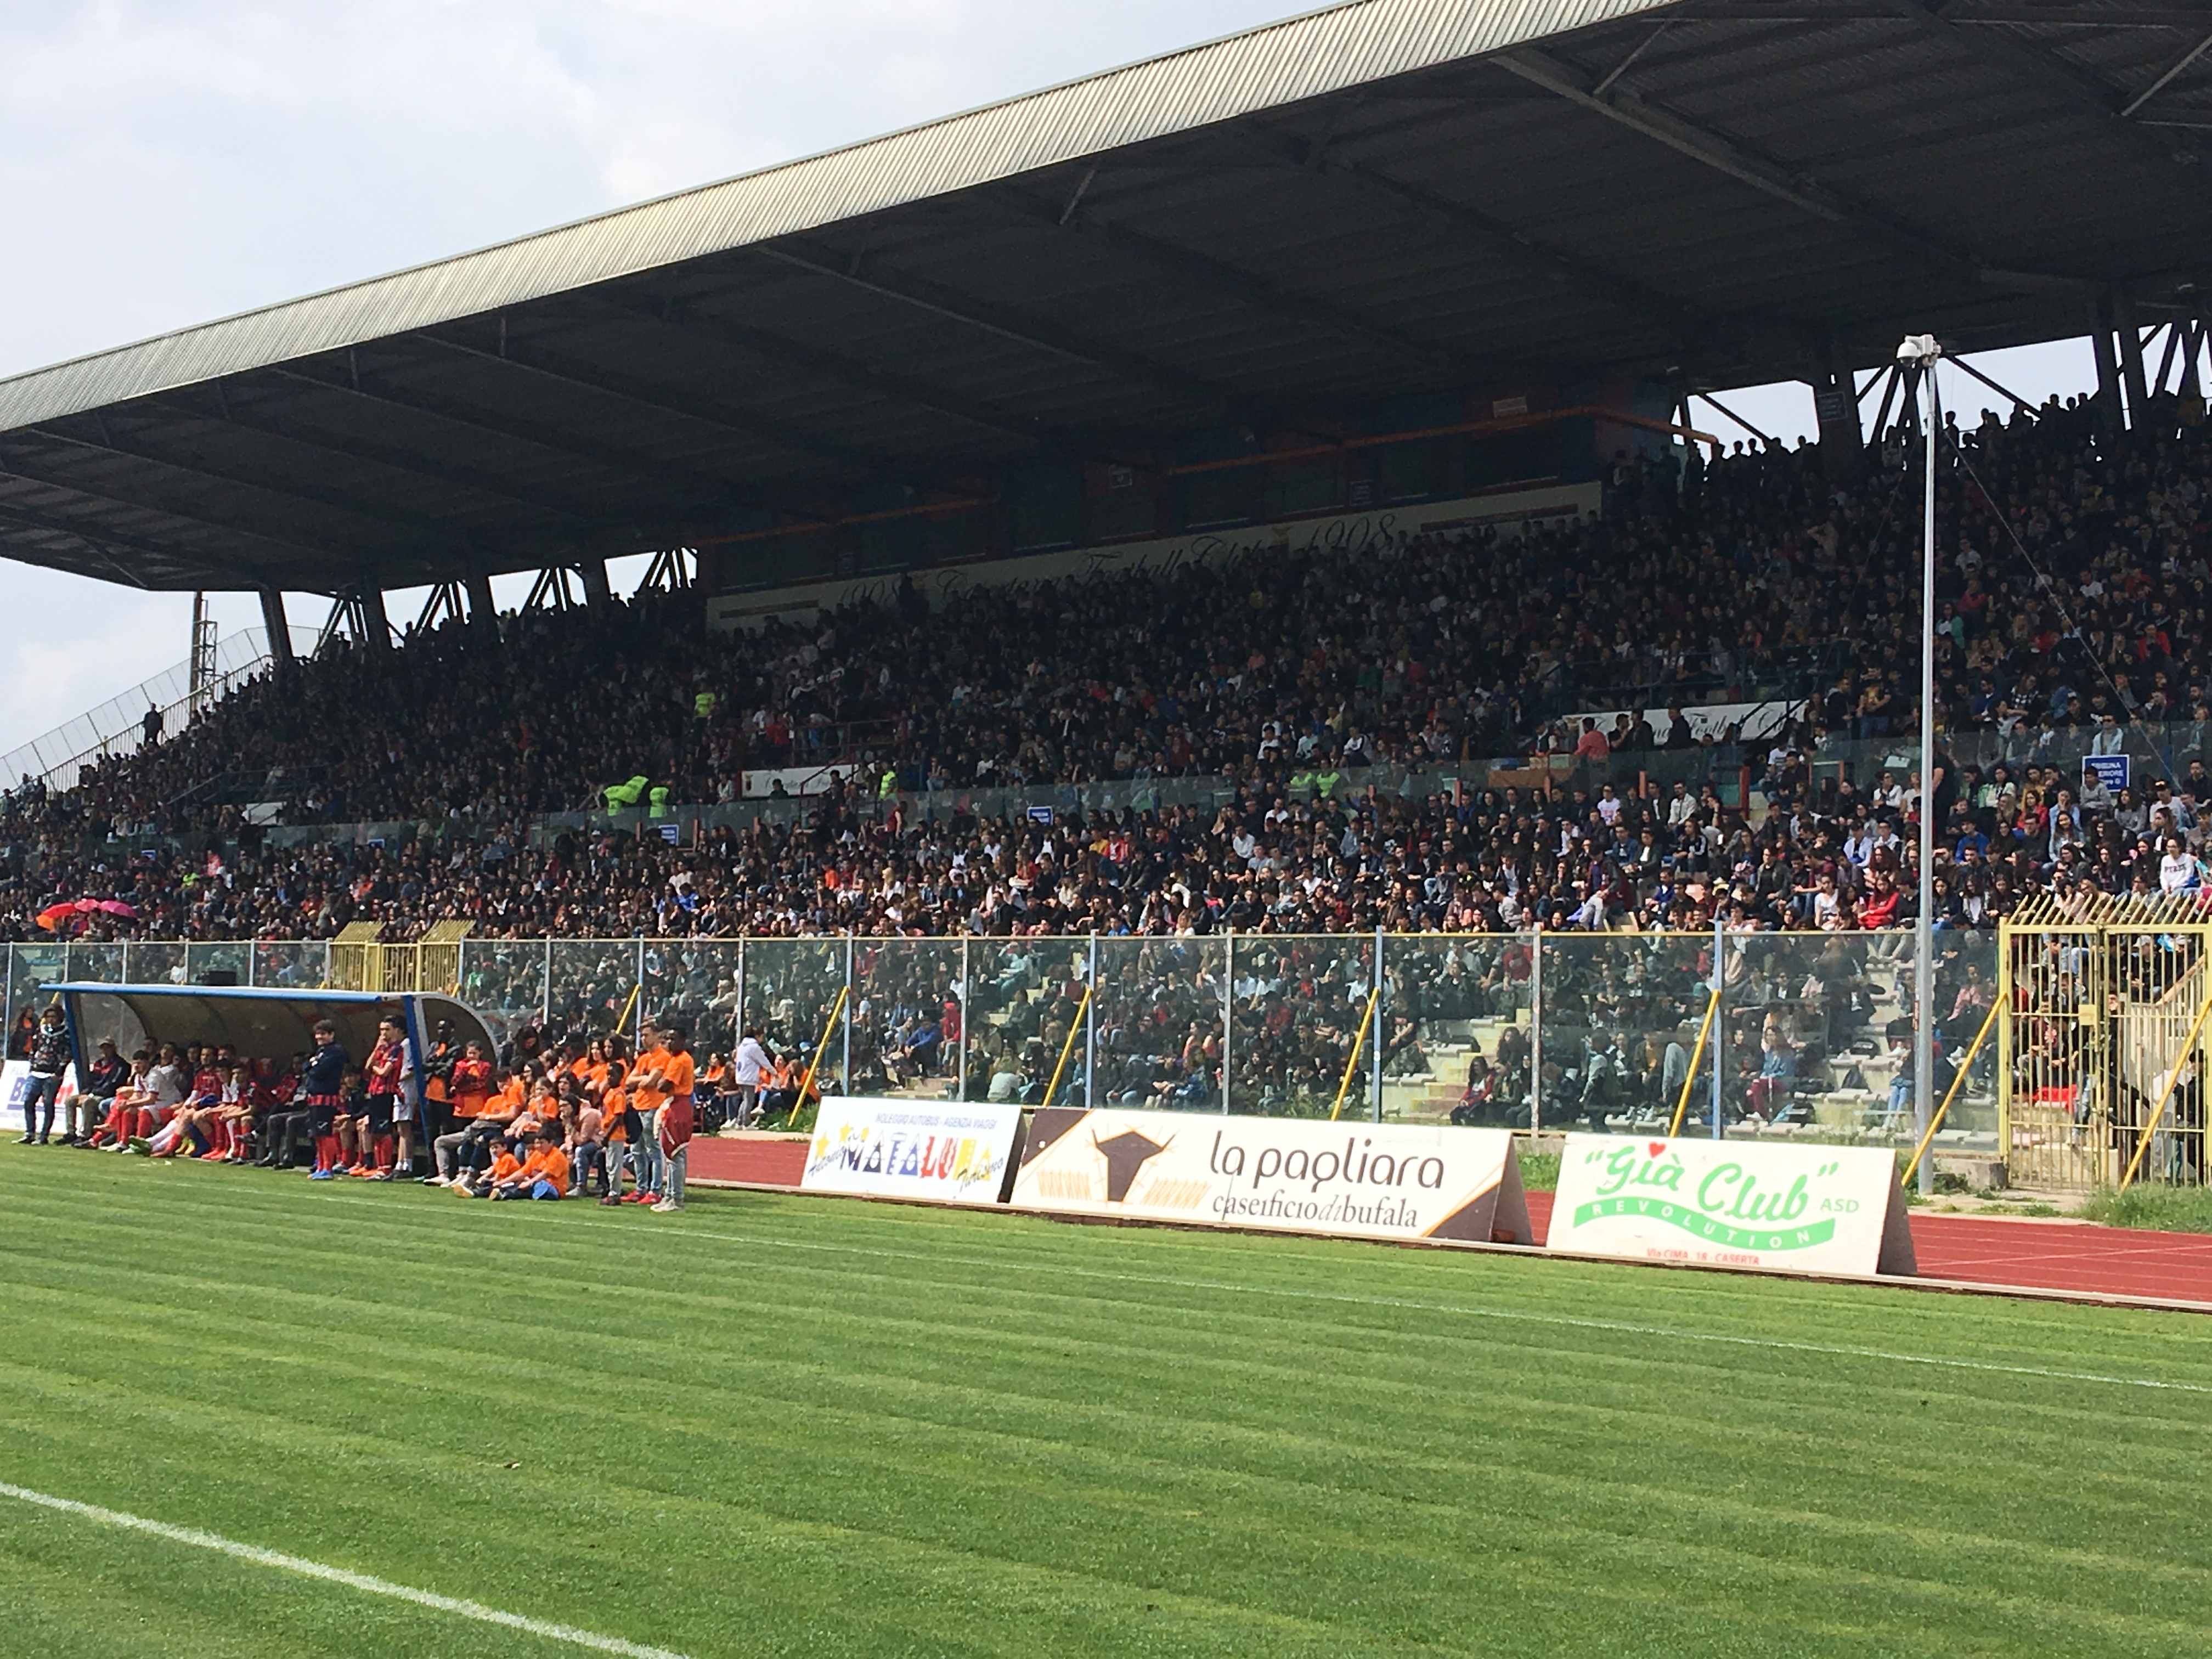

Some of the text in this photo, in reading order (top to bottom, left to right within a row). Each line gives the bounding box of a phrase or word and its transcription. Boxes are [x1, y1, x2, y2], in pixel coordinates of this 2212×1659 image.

[876, 1113, 909, 1125] NOLEGGIO
[909, 1114, 940, 1127] AUTOBUS
[943, 1116, 973, 1128] AGENZIA
[1210, 1130, 1444, 1193] la pagliara
[1820, 1198, 1860, 1213] ASD
[1592, 1200, 1810, 1249] REVOLUTION
[1647, 1248, 1661, 1258] Via
[1696, 1251, 1708, 1261] 18
[1715, 1253, 1759, 1265] CASERTA
